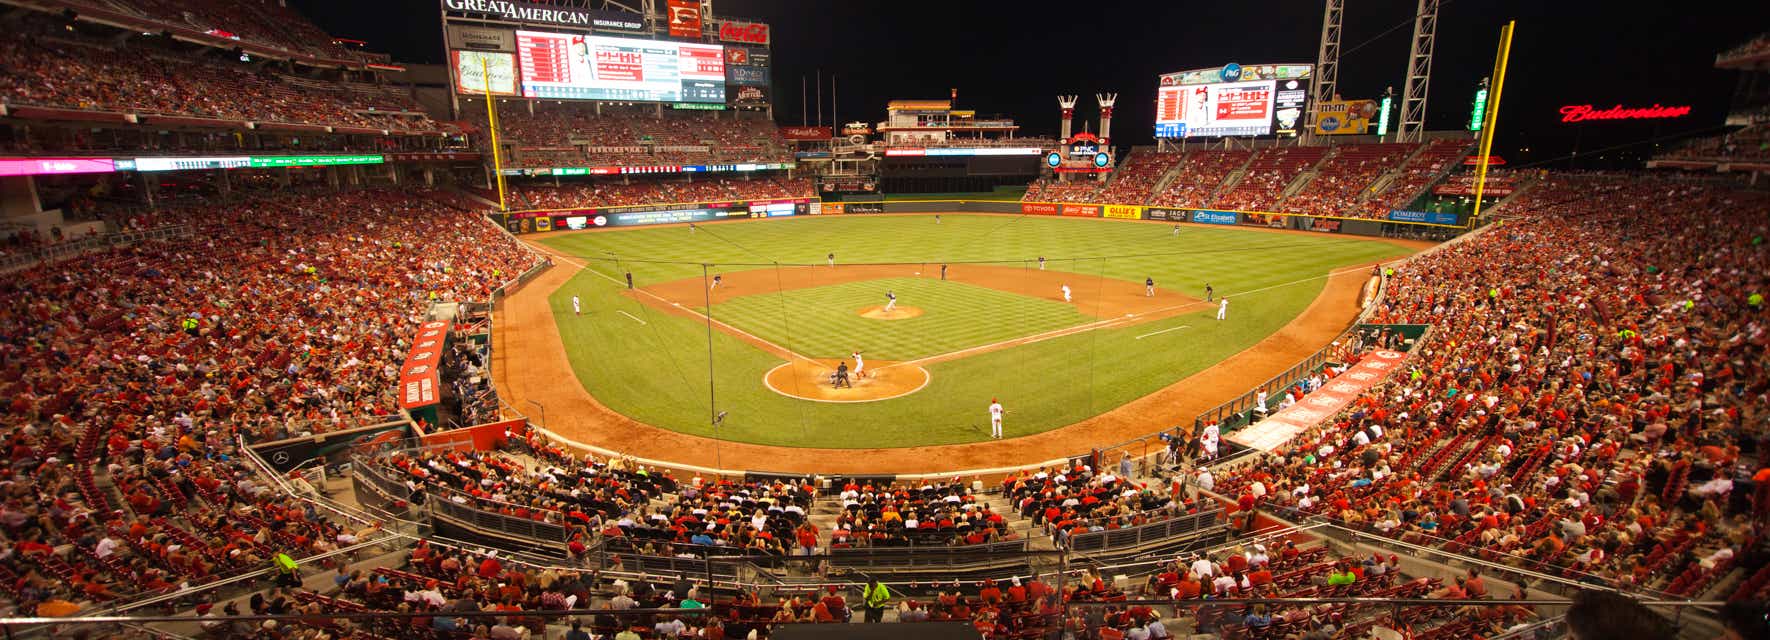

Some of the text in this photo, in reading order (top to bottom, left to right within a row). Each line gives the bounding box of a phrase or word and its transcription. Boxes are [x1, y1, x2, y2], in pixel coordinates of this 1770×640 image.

[593, 19, 624, 28] INSURANCE
[1225, 69, 1239, 78] P&G
[1559, 103, 1692, 123] Budweiser
[1393, 209, 1426, 218] POMEROY
